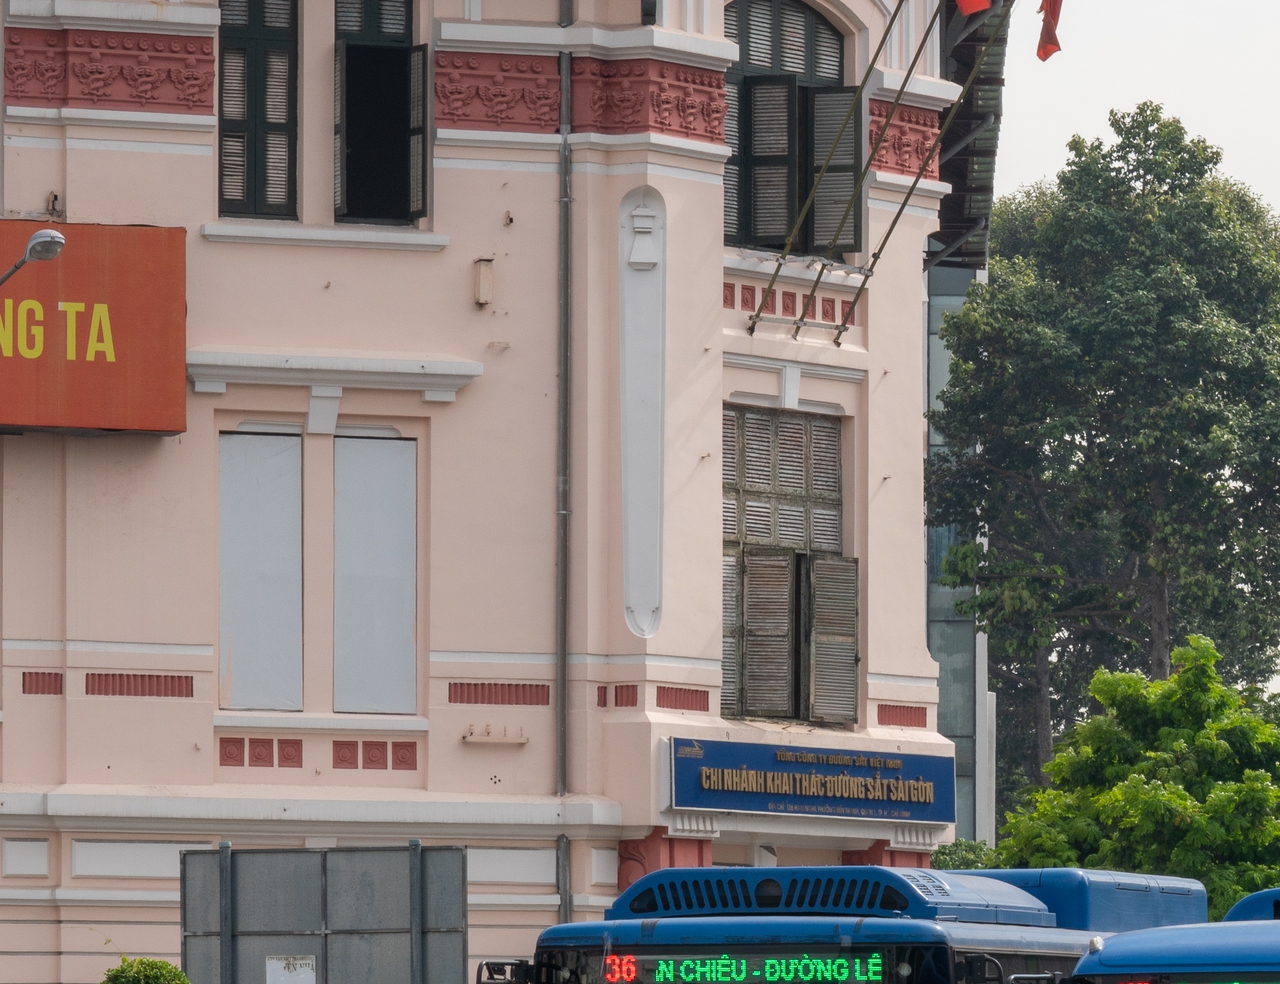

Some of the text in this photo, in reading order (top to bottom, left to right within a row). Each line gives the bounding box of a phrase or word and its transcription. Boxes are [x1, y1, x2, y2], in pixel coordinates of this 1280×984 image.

[58, 301, 116, 362] TA
[701, 765, 934, 803] CHI NHÁNH KHAI THÁC ĐƯỜNG SẮT SÀI GÒN
[605, 955, 636, 982] 36
[764, 954, 849, 981] ĐƯỜNG
